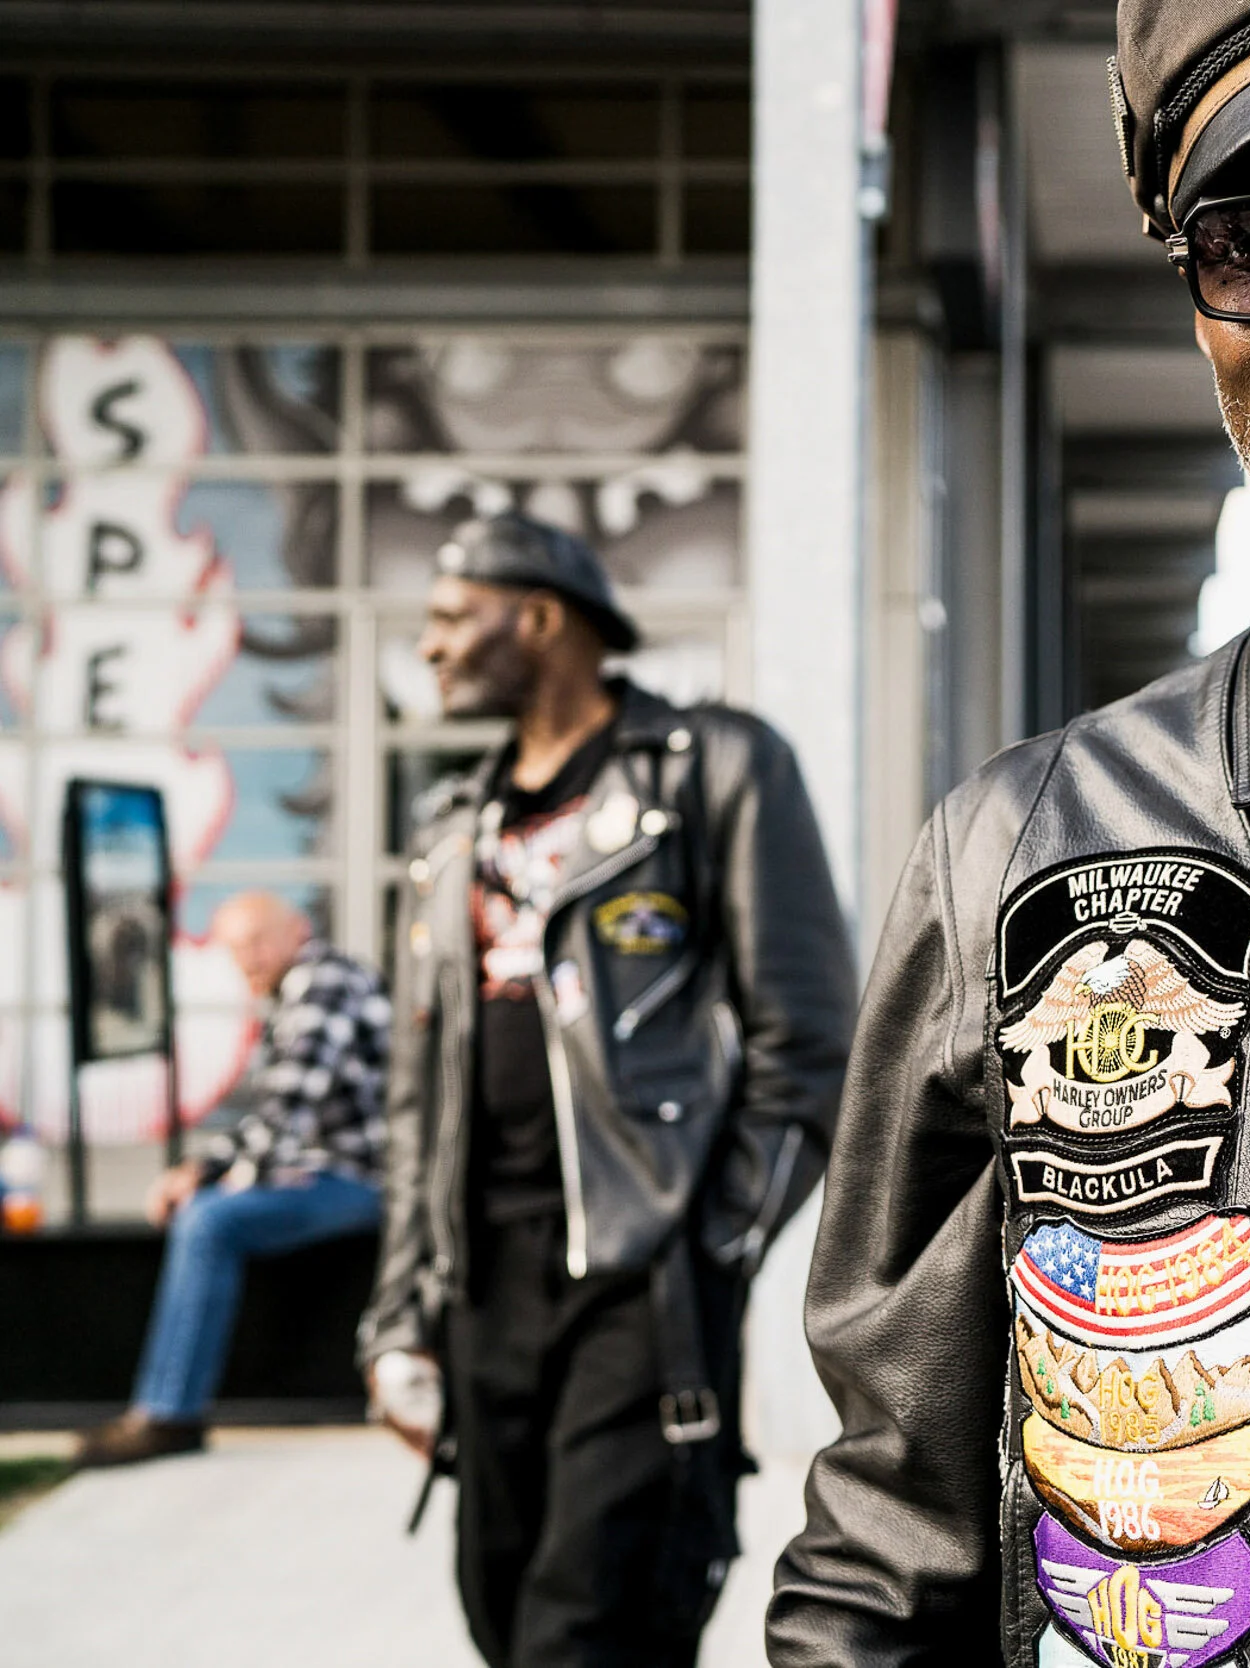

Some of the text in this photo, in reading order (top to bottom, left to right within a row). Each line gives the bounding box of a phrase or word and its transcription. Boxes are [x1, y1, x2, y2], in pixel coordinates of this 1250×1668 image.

[1067, 863, 1204, 899] MILWAUKEE
[1074, 888, 1184, 922] CHAPTER
[1053, 1069, 1168, 1108] HARLEY OWNERS
[1079, 1105, 1133, 1128] GROUP
[1042, 1158, 1174, 1200] BLACKULA
[1099, 1371, 1160, 1410] HOG
[1100, 1411, 1161, 1445] 1985
[1097, 1501, 1161, 1541] 1986
[1087, 1565, 1163, 1651] HOG
